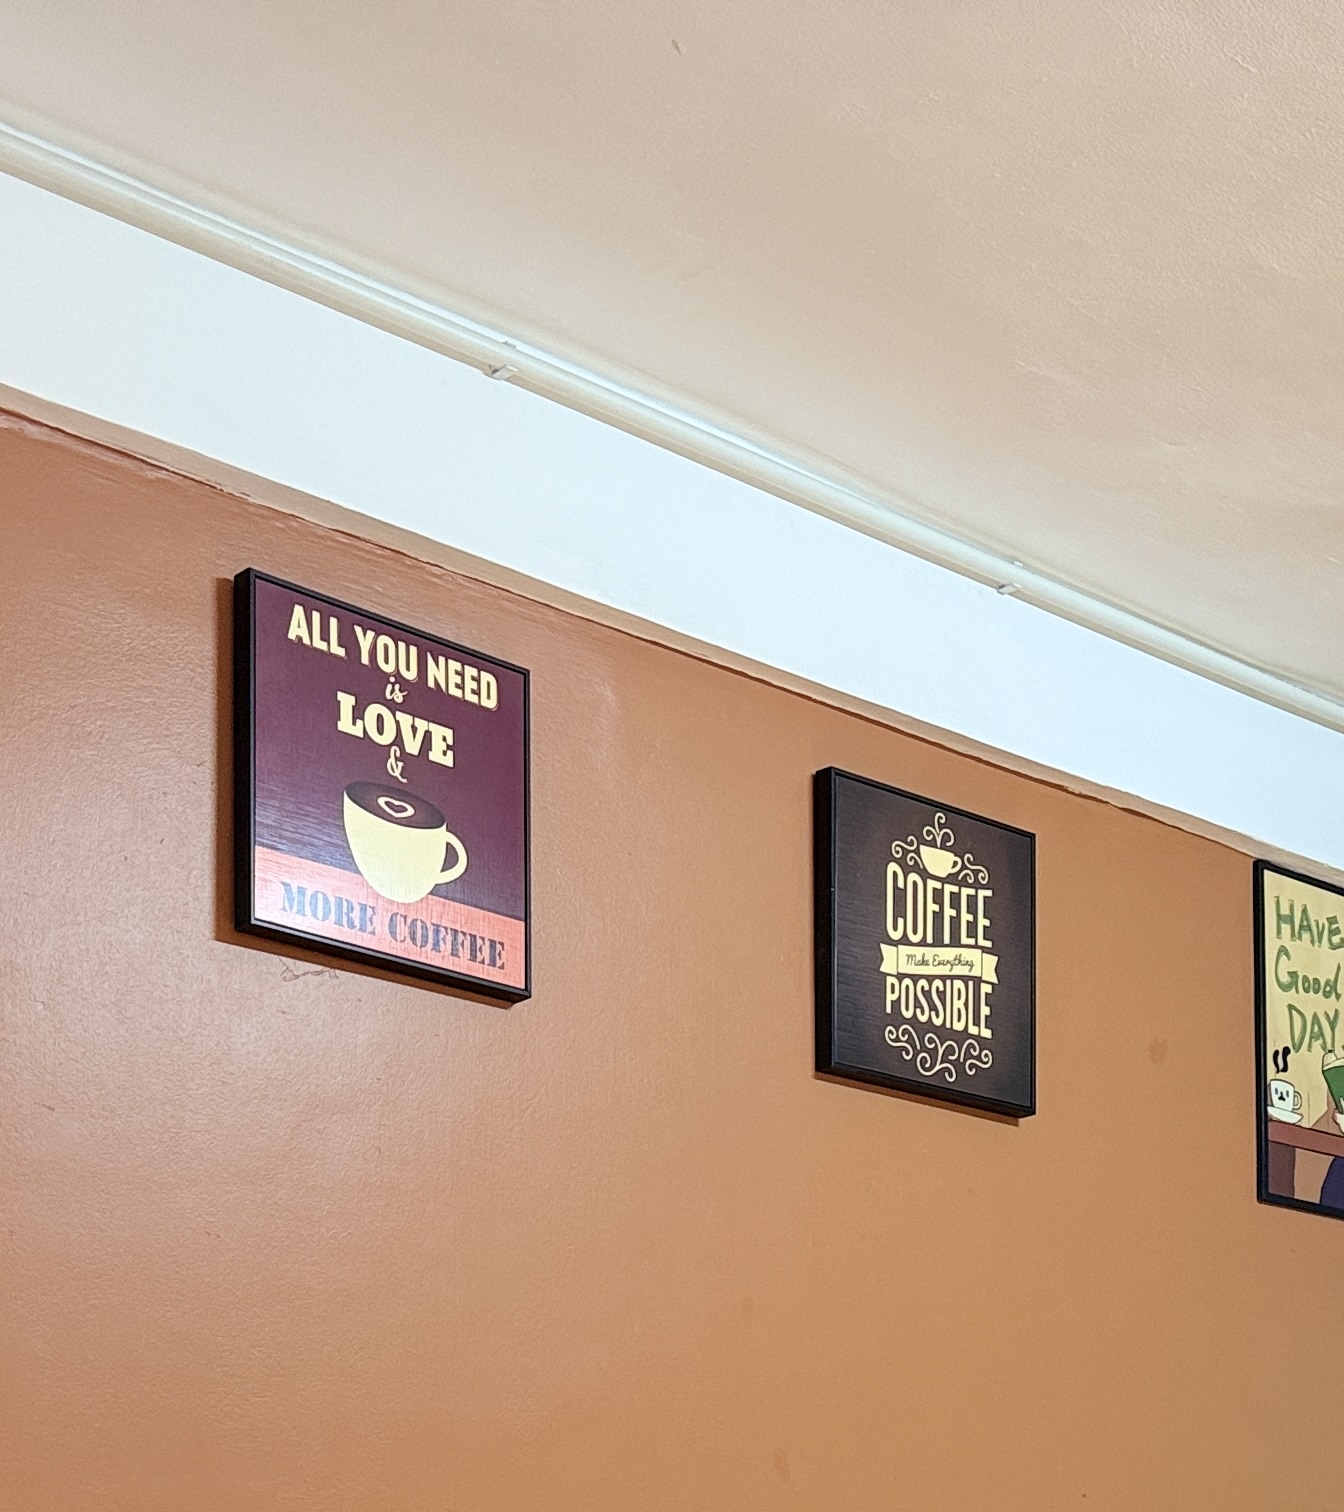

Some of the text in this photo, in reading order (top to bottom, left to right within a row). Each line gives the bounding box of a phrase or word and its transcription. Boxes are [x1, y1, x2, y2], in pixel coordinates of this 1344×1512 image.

[287, 604, 499, 711] ALL YOU NEED
[385, 676, 408, 703] is
[336, 691, 455, 768] LOVE
[385, 746, 408, 774] &
[280, 881, 506, 971] MORE COFFEE
[885, 861, 993, 948] COFFEE
[905, 952, 975, 973] Make Everything
[1275, 945, 1342, 1000] Good
[885, 975, 993, 1039] POSSIBLE
[1287, 1003, 1340, 1053] DAY
